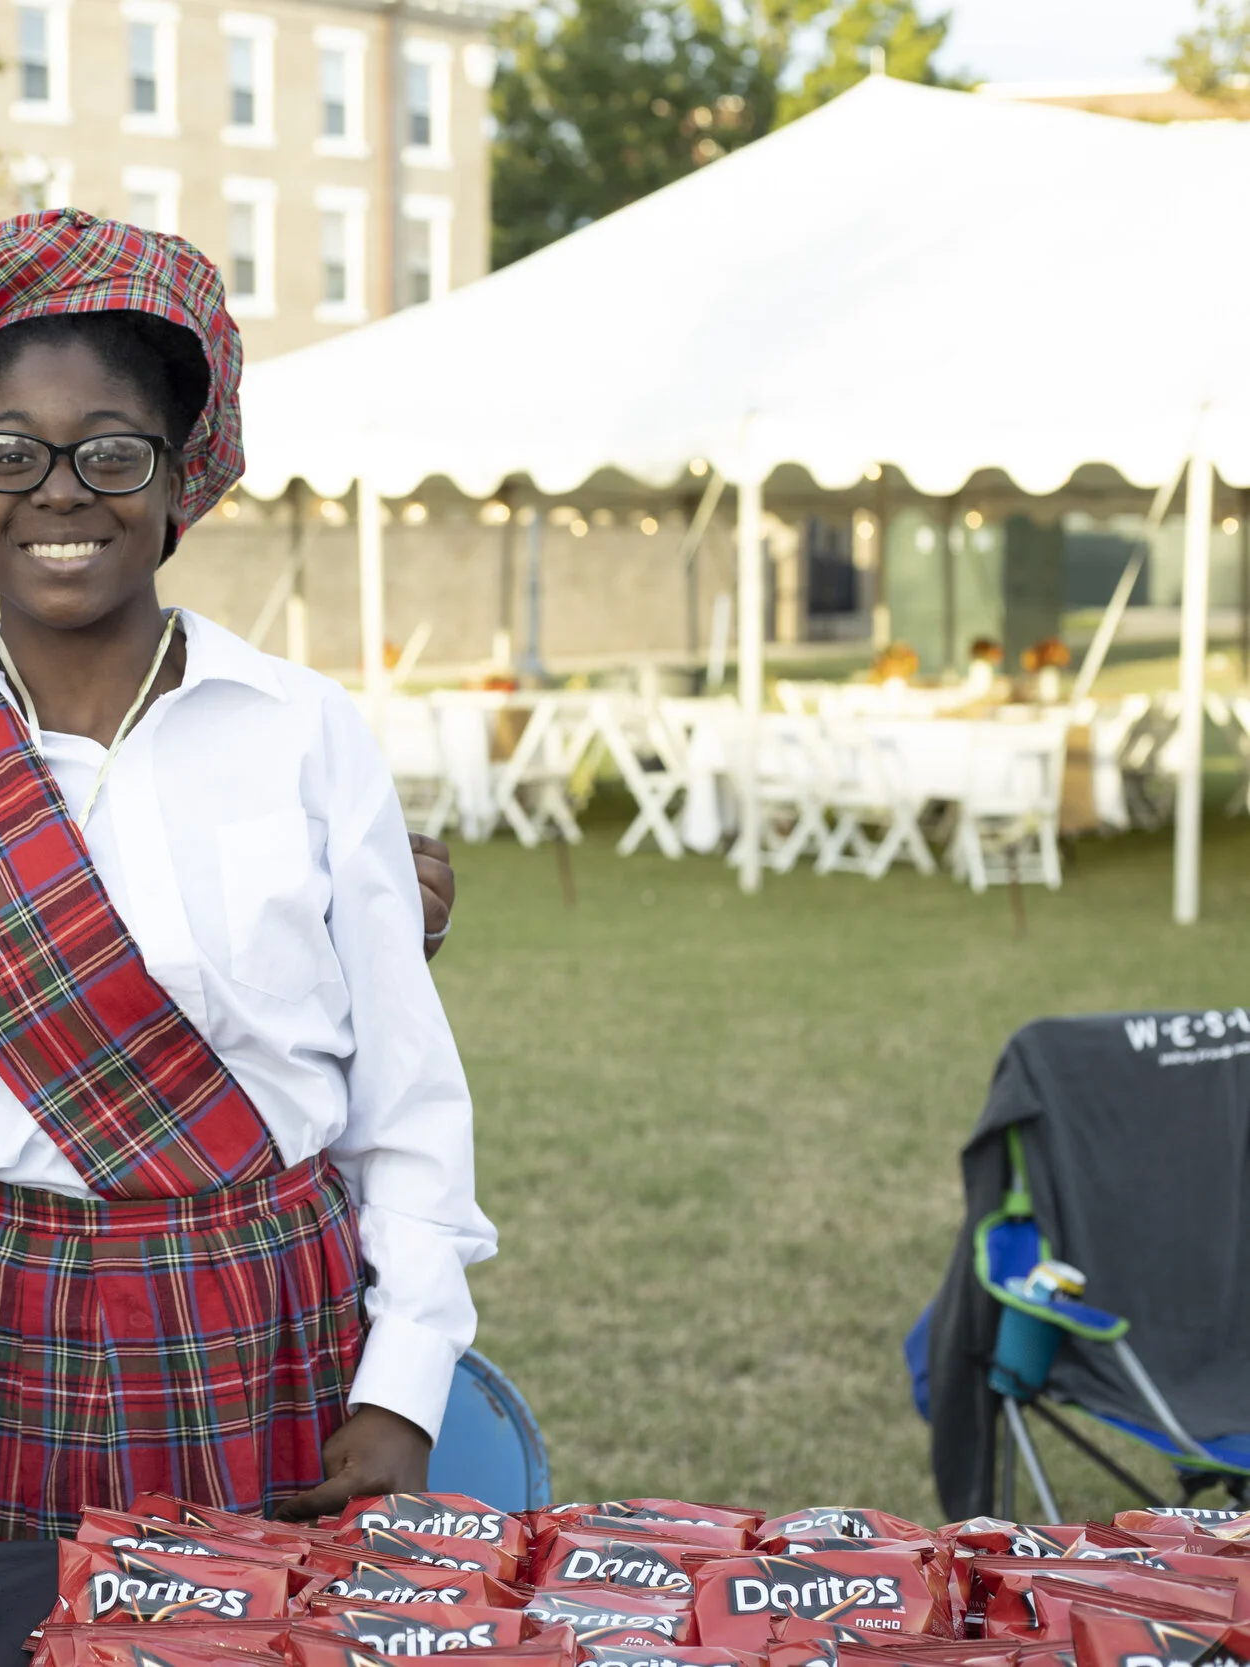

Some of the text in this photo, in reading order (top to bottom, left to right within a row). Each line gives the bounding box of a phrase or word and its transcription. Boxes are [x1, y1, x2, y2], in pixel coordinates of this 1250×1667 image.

[785, 1513, 873, 1538] Dorit
[564, 1550, 691, 1592] Dorito
[93, 1572, 247, 1618] Doritos
[734, 1577, 898, 1611] Doritos
[338, 1624, 491, 1657] ritos
